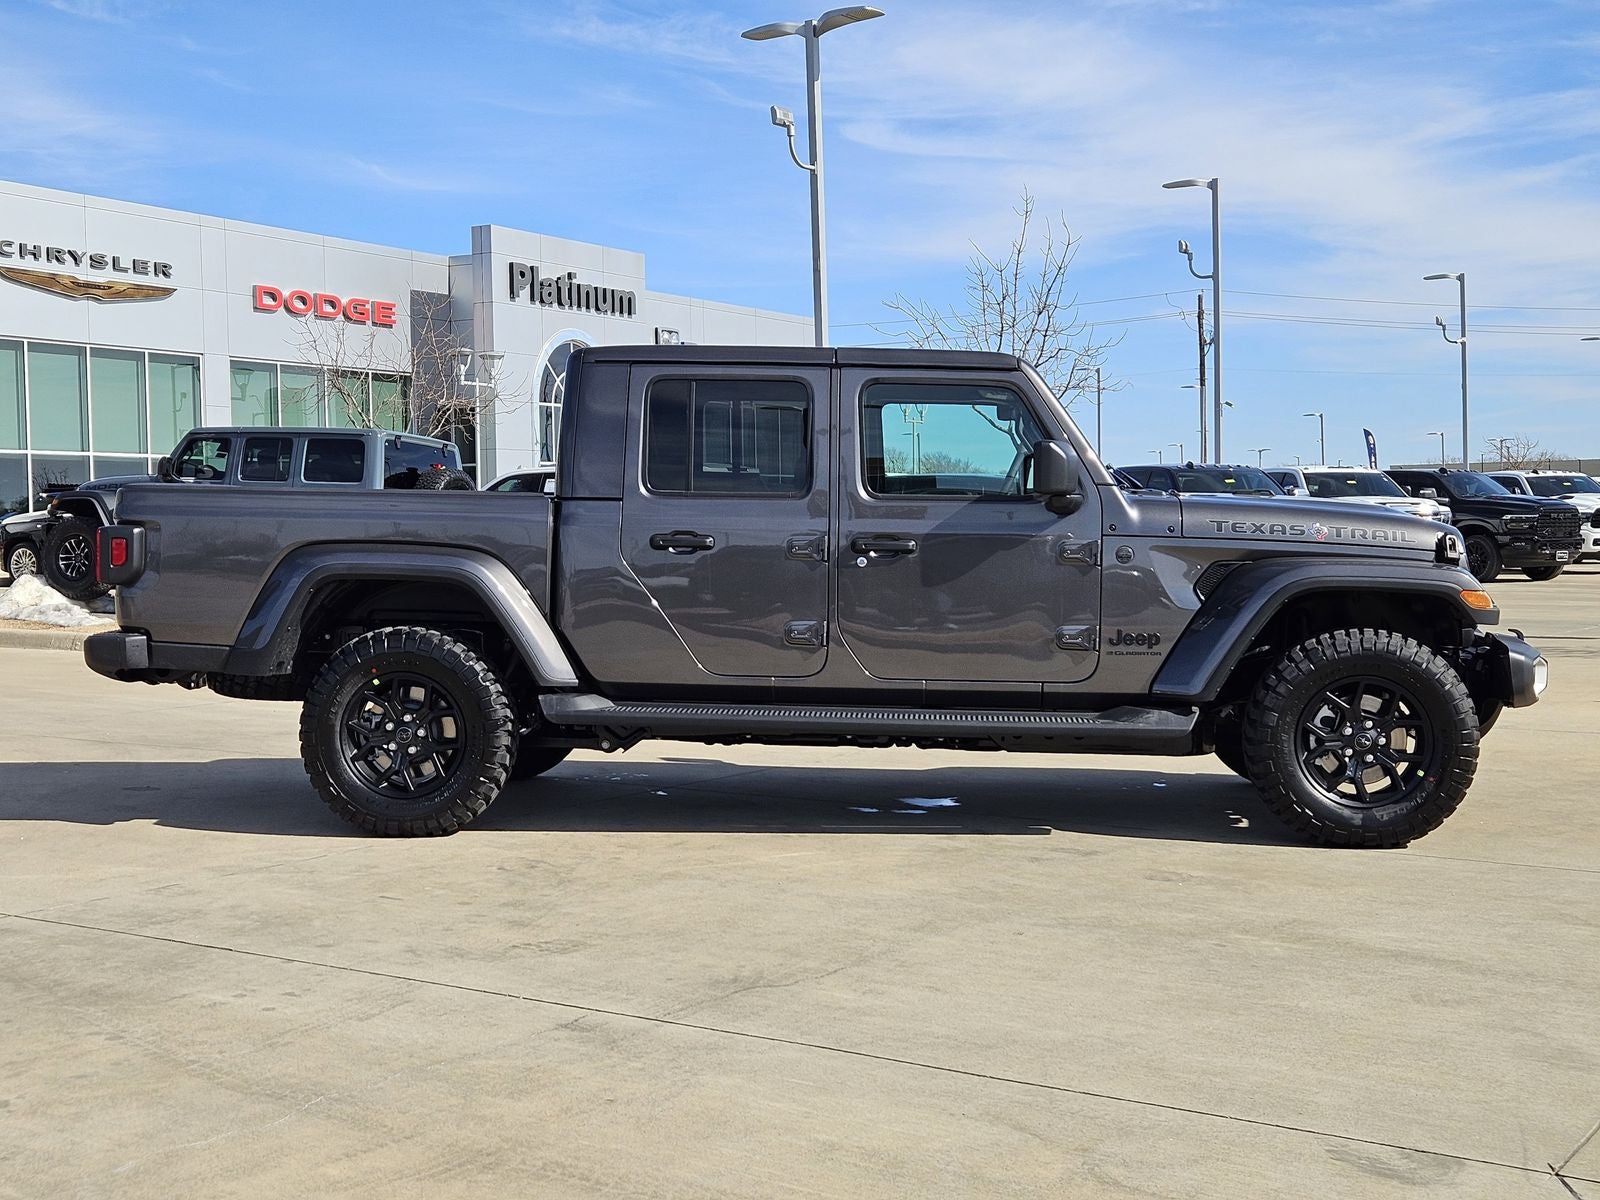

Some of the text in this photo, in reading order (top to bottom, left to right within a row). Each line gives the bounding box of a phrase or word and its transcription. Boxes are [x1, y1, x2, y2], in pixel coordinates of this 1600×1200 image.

[0, 240, 173, 279] CHRYSLER
[252, 284, 397, 329] DODGE
[508, 261, 637, 319] Platinum
[1207, 519, 1417, 543] TEXAS TRAIL
[1108, 628, 1160, 649] Jeep
